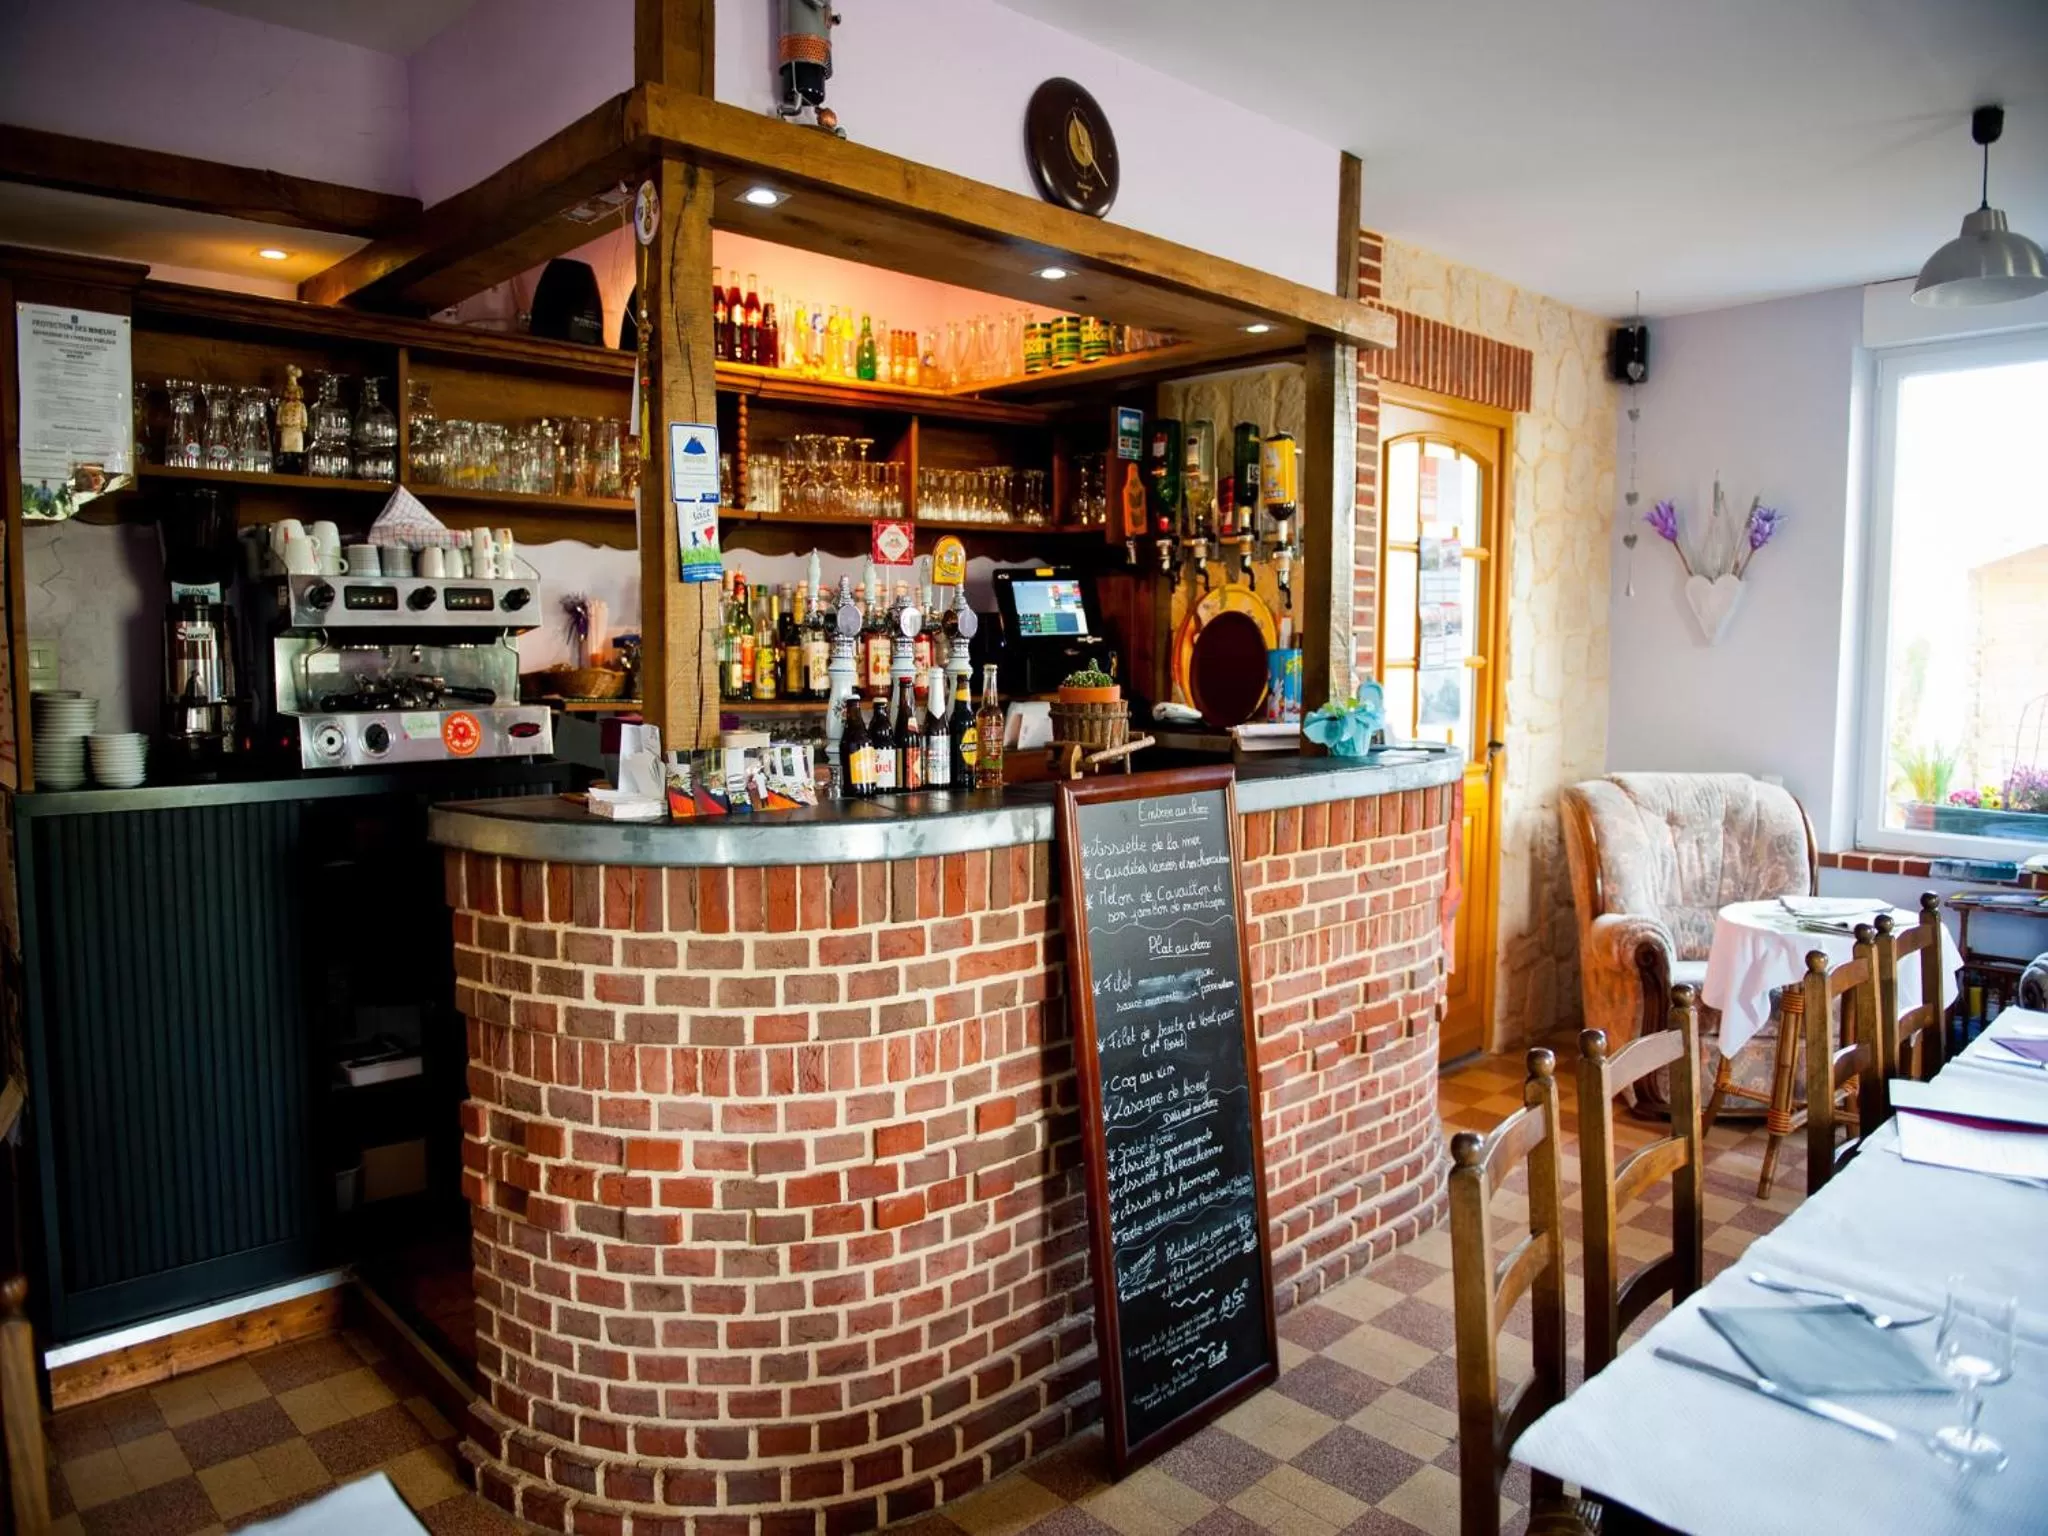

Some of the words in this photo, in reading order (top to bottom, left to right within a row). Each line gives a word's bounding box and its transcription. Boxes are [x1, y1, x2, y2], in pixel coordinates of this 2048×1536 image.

[1151, 834, 1164, 852] de
[1166, 832, 1180, 850] la
[1100, 883, 1134, 906] Melon
[1140, 884, 1152, 903] de
[1213, 875, 1224, 893] et
[1148, 934, 1173, 954] Plat
[1175, 944, 1190, 955] au
[1103, 967, 1133, 994] Filet
[1106, 1024, 1137, 1049] Filet
[1187, 1011, 1197, 1031] de
[1110, 1074, 1137, 1093] Coq
[1139, 1071, 1153, 1084] au
[1156, 1063, 1176, 1079] vin
[1112, 1094, 1163, 1120] Lasagne
[1167, 1083, 1179, 1102] de
